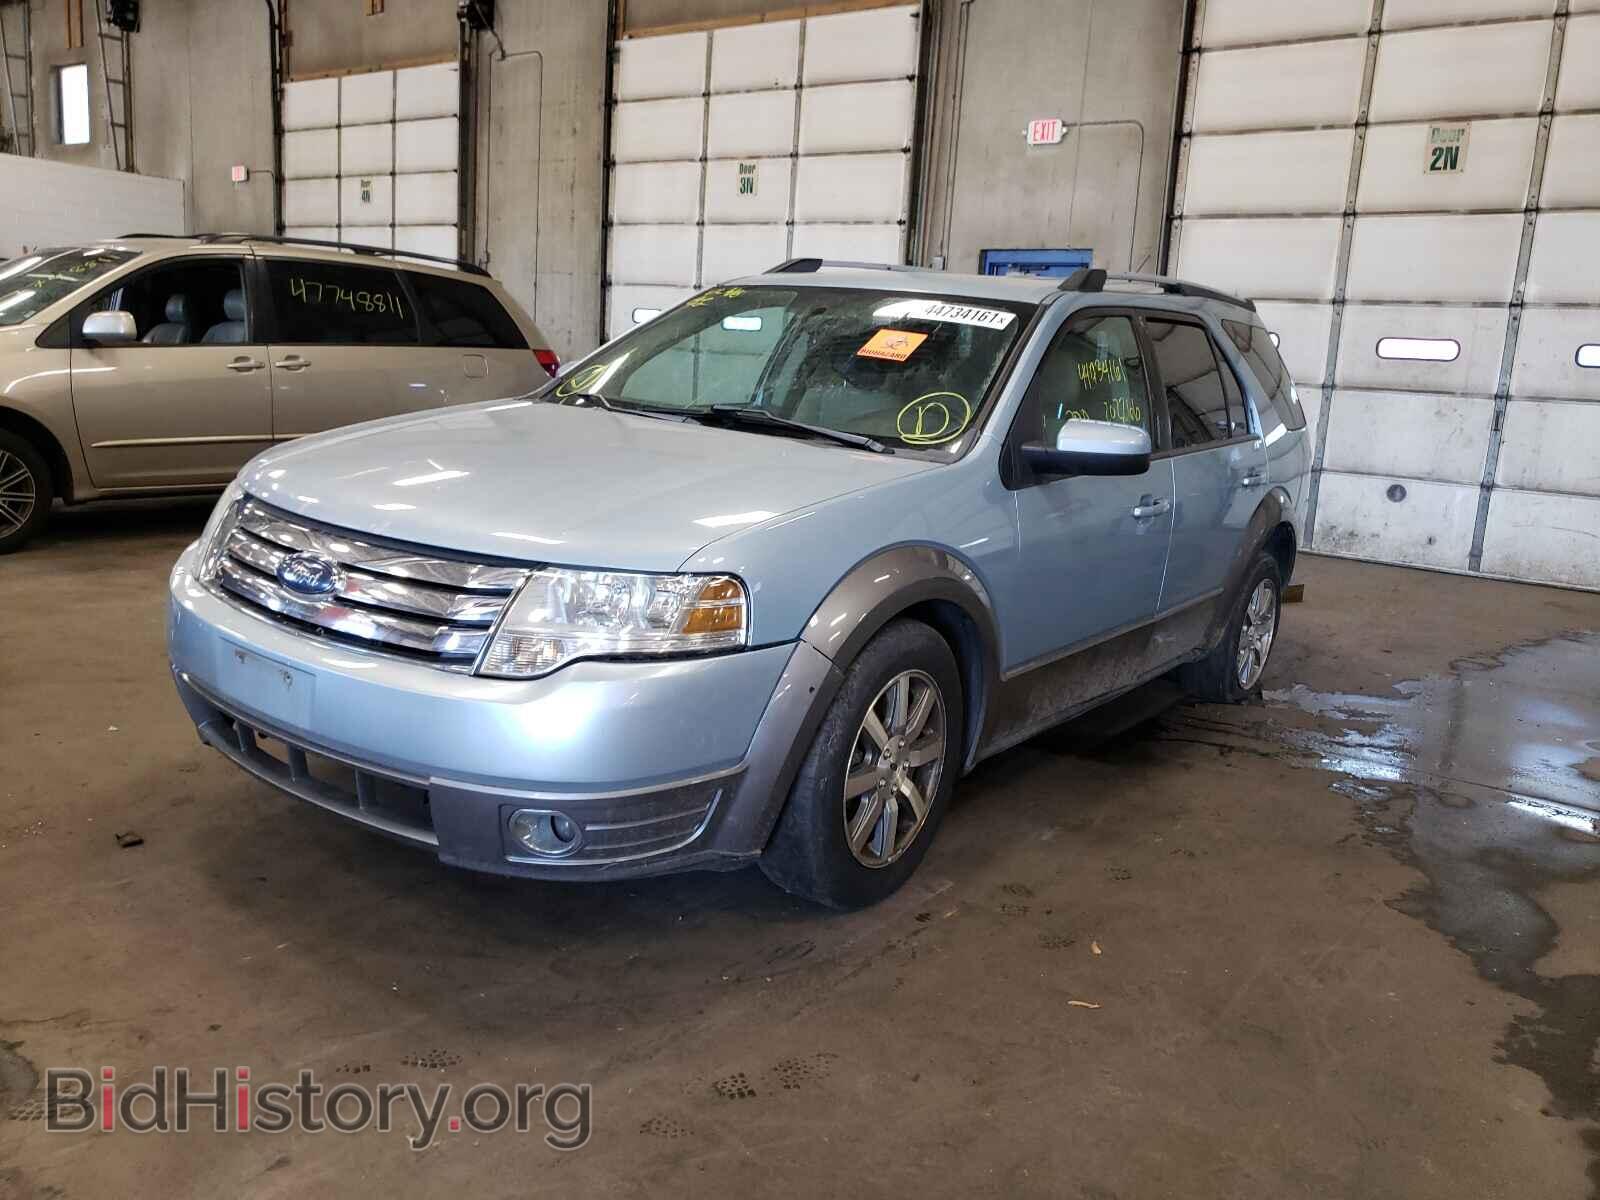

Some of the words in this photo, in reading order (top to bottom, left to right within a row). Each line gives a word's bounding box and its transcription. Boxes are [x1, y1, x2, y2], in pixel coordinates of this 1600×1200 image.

[1032, 120, 1057, 142] EXIT
[740, 162, 756, 174] Door
[1430, 146, 1460, 171] 2N
[740, 176, 754, 194] 3N
[290, 277, 404, 320] 47748811
